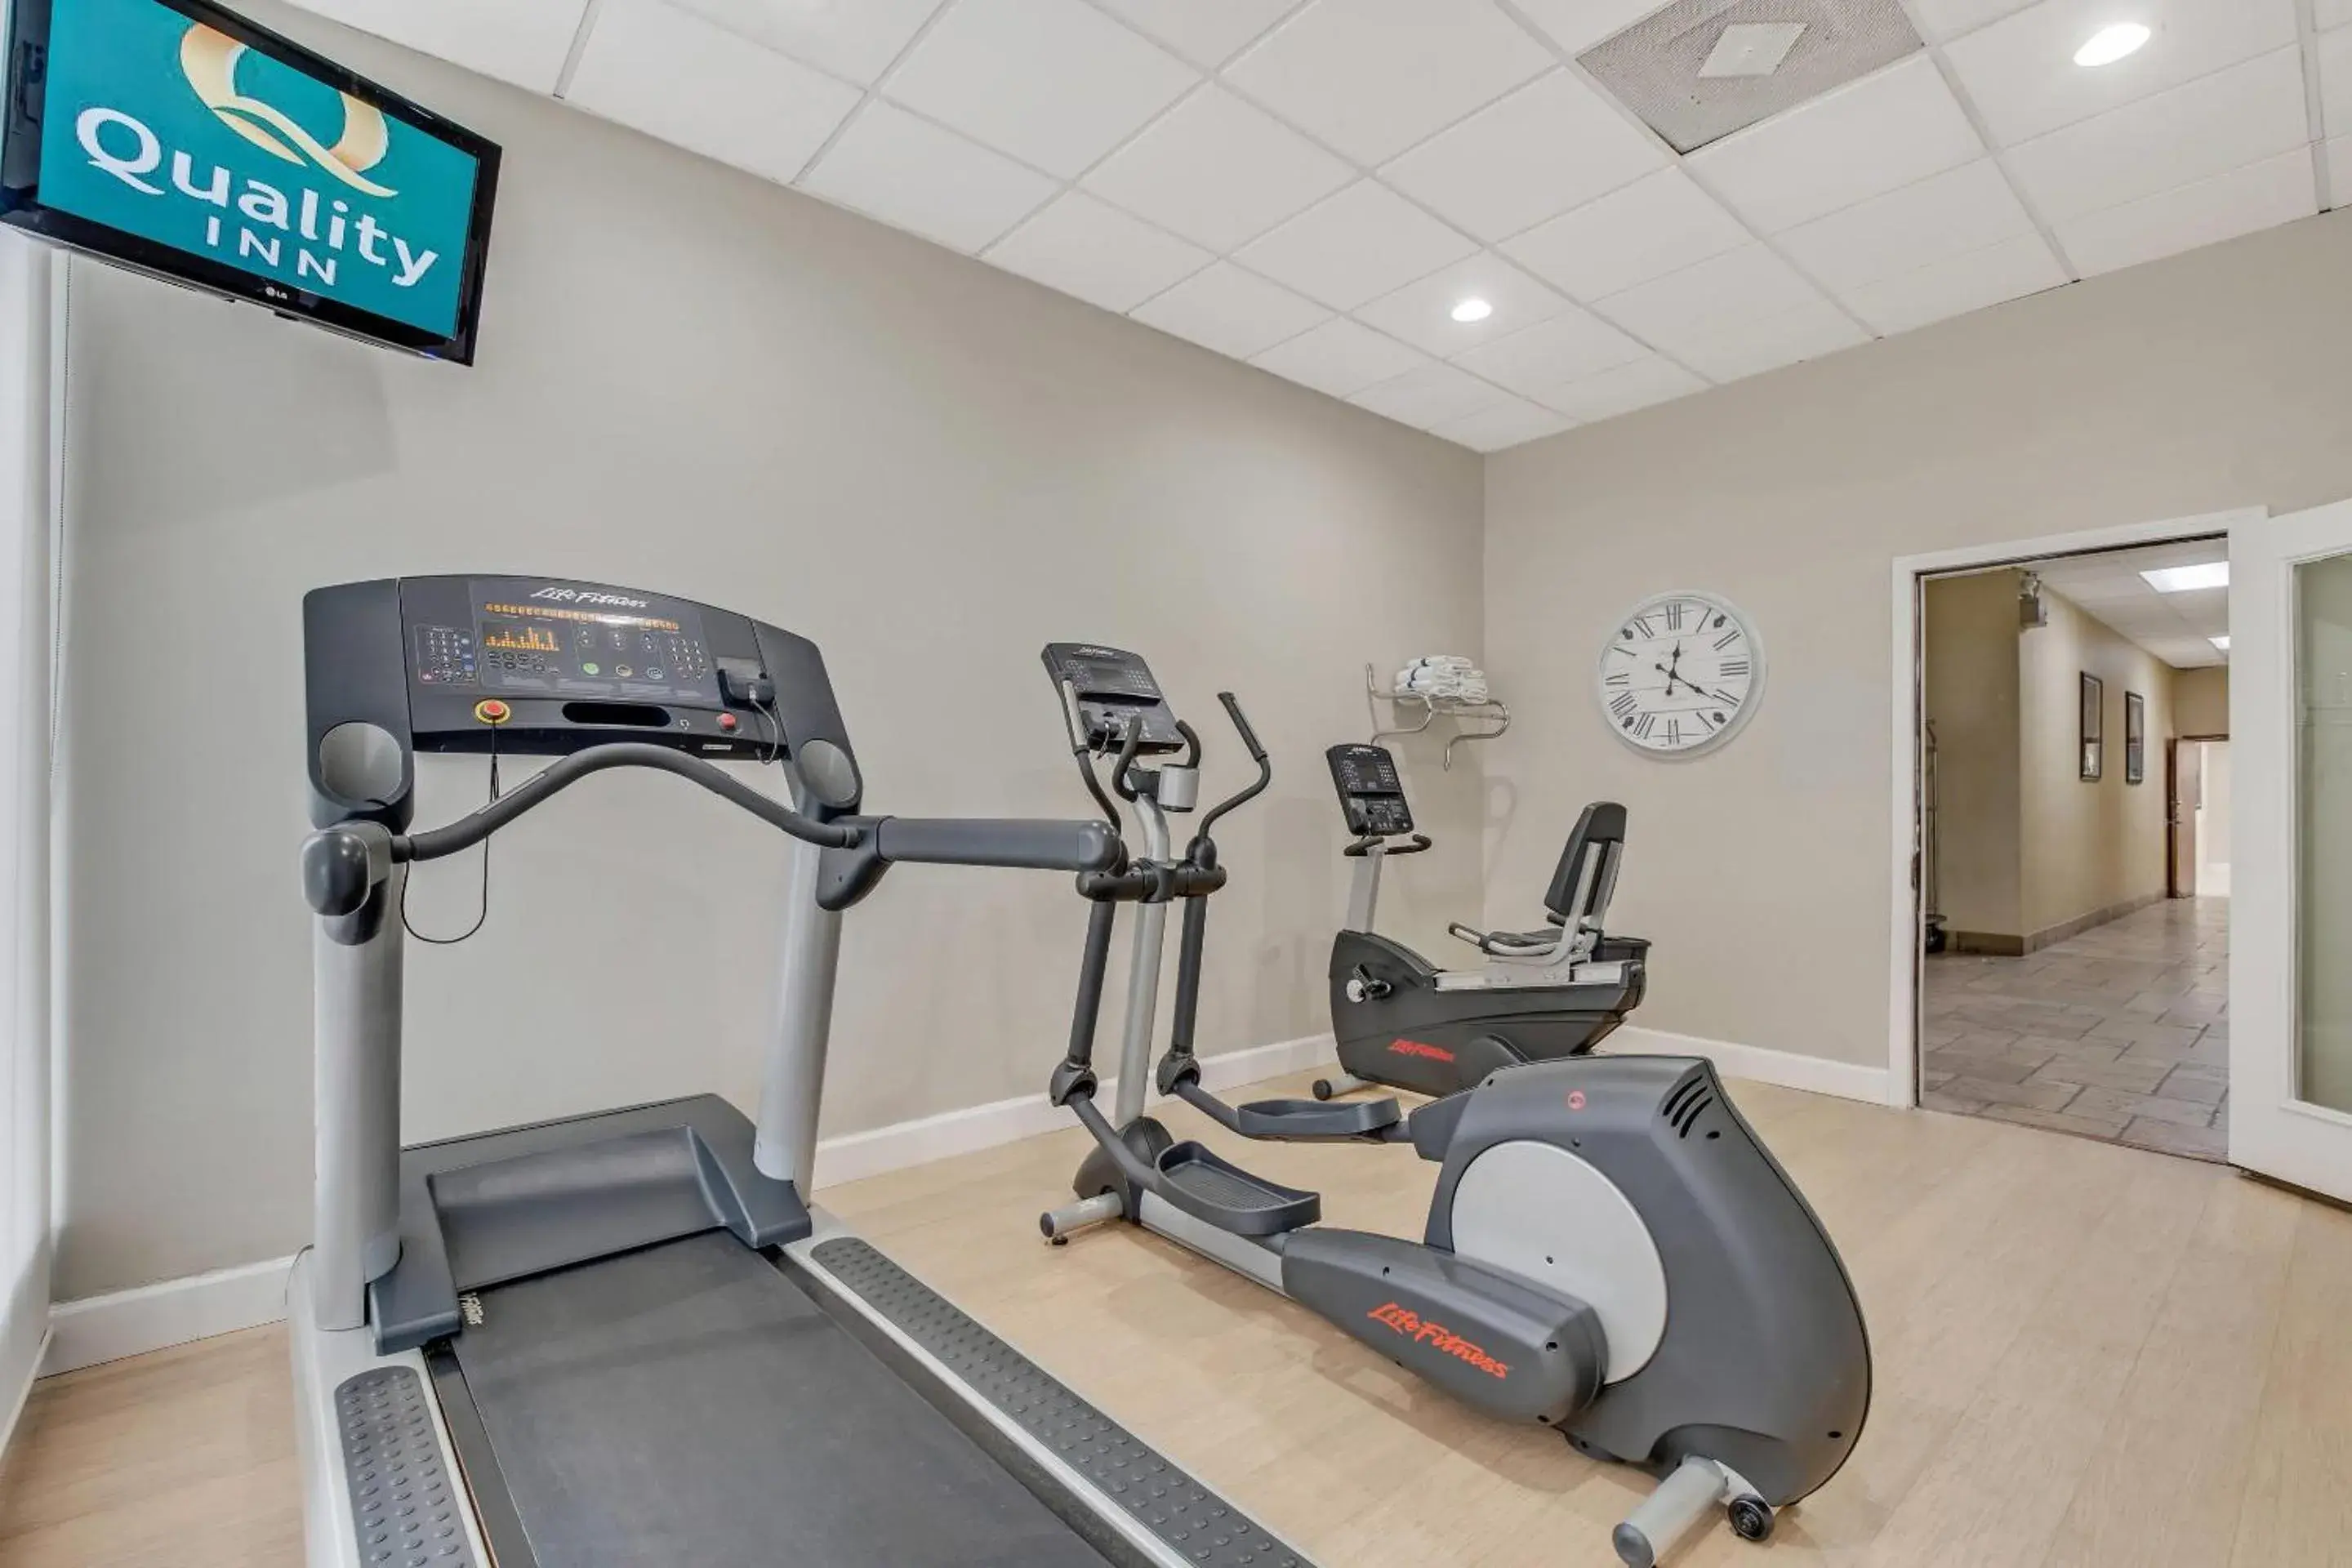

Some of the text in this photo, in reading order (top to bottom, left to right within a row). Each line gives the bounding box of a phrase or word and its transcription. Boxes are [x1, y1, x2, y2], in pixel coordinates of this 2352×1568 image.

[76, 107, 439, 287] Quality
[207, 216, 336, 286] INN
[1366, 1301, 1508, 1380] Life Fitness
